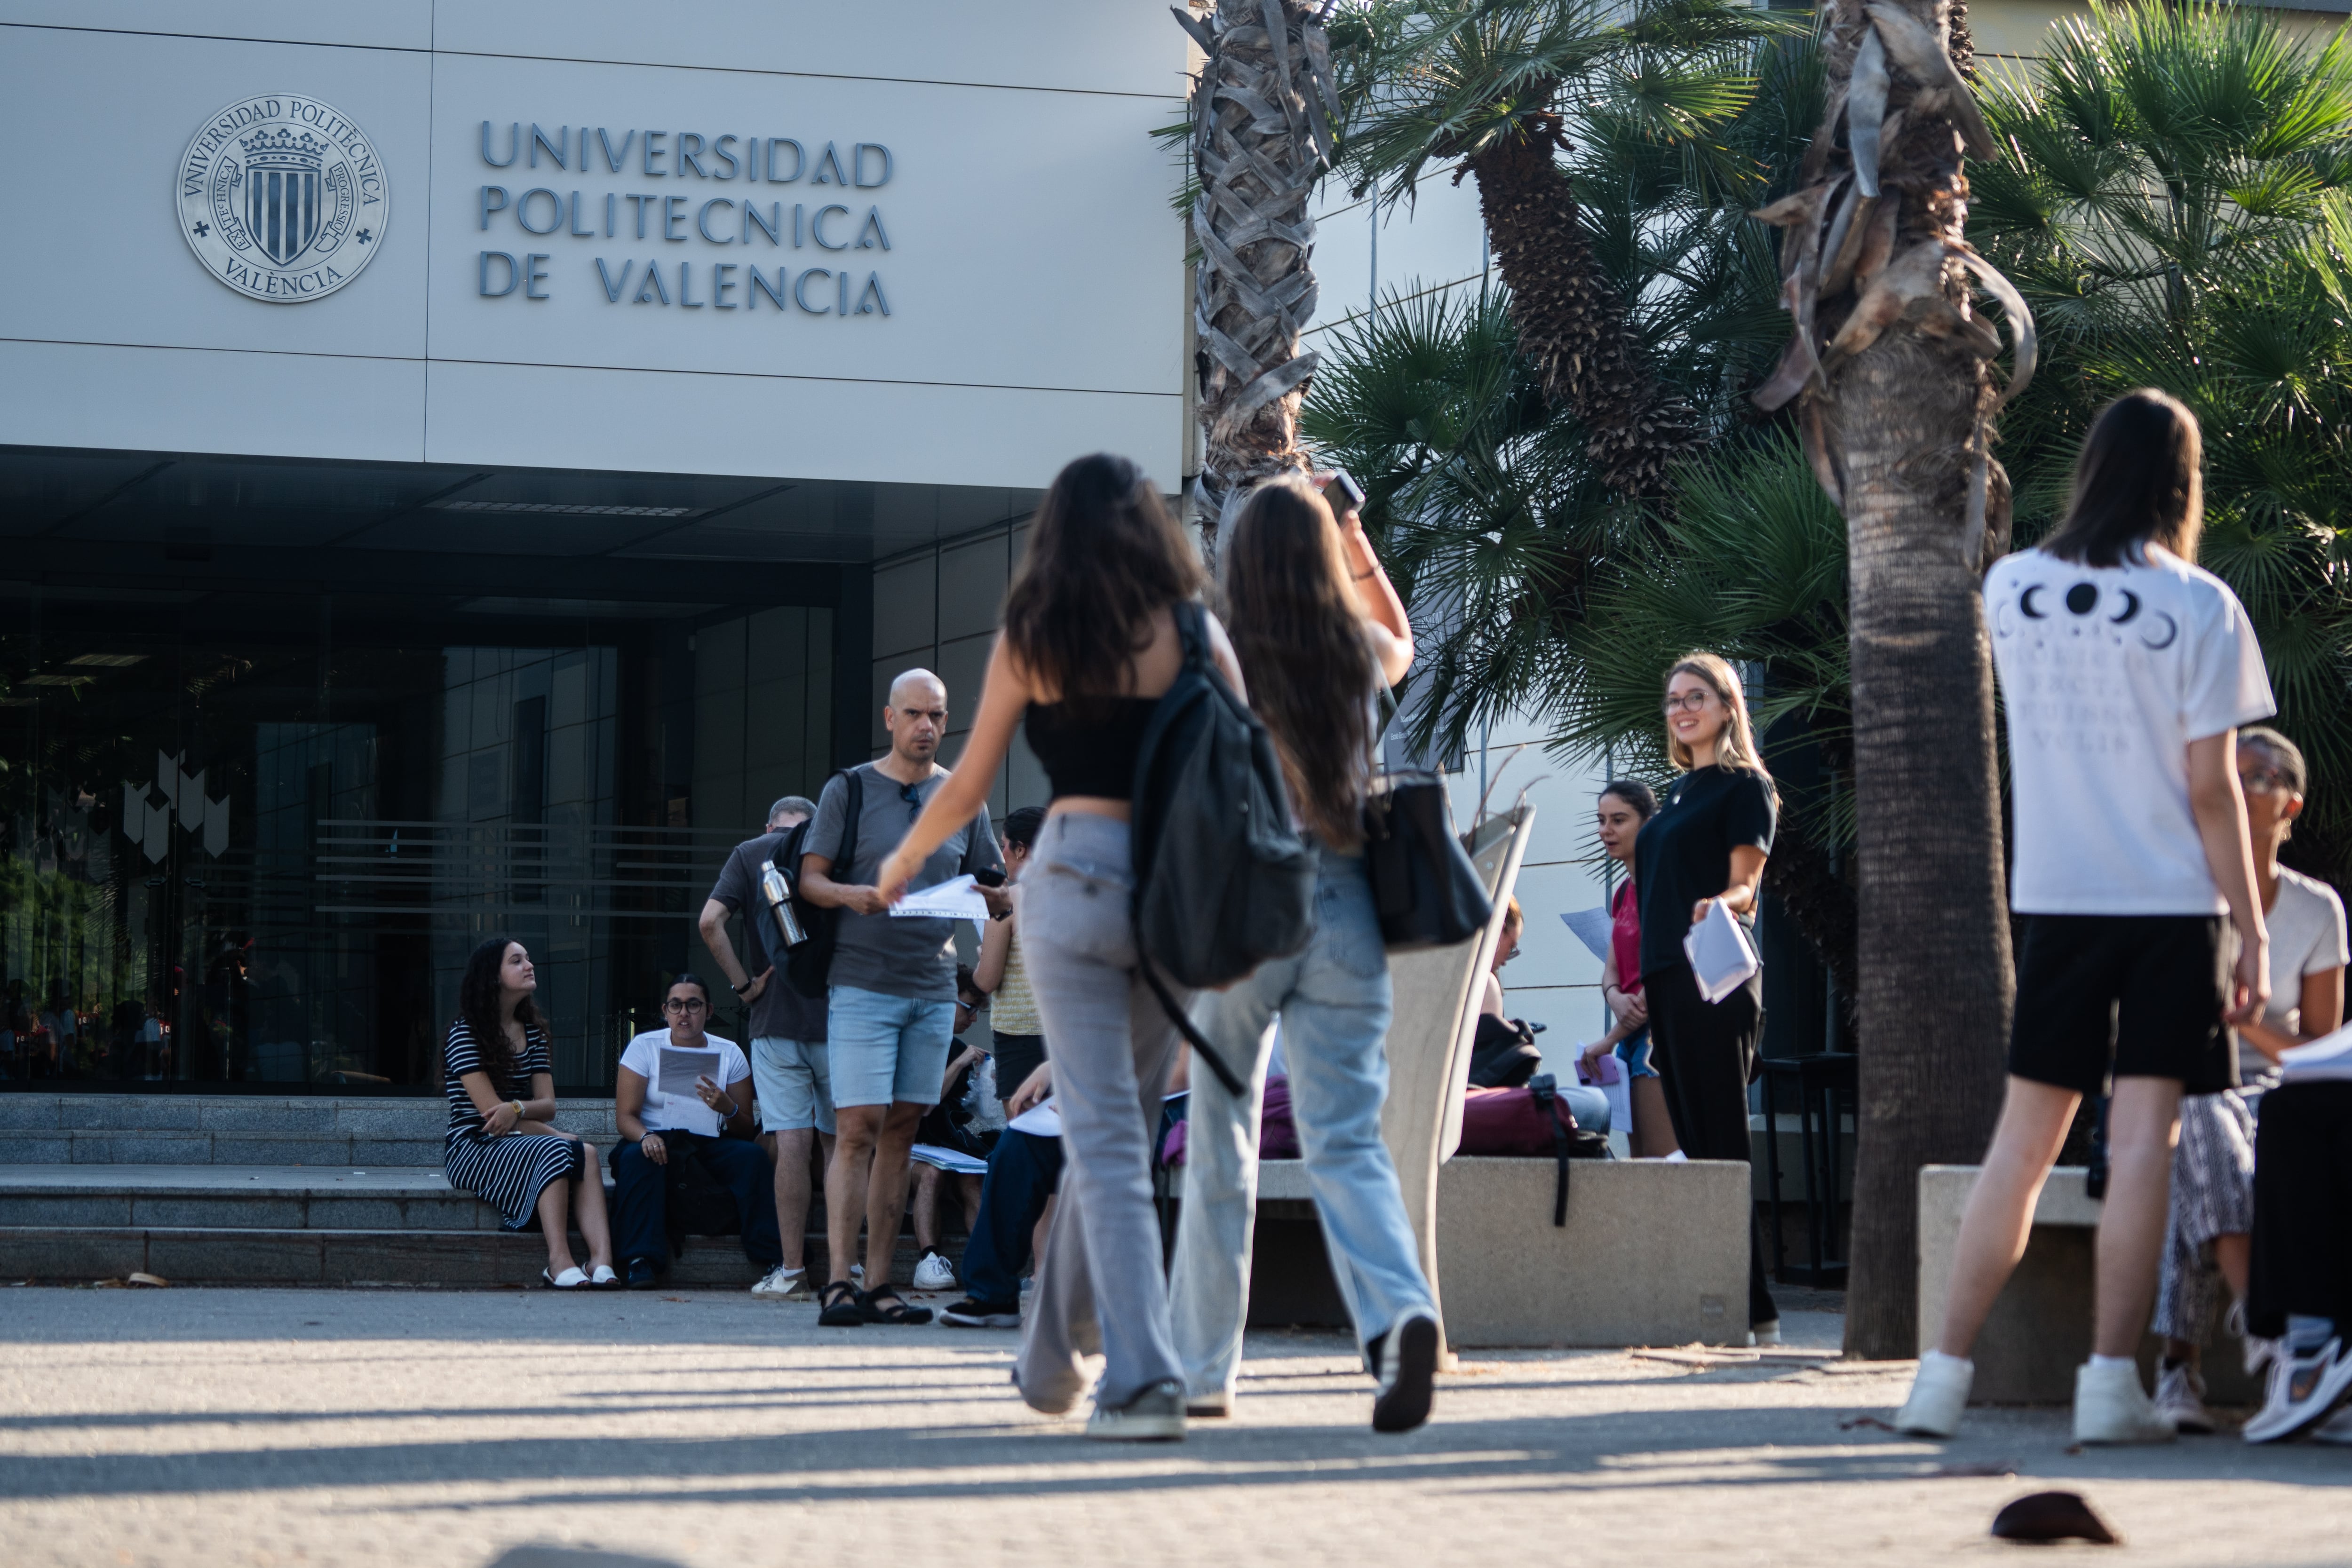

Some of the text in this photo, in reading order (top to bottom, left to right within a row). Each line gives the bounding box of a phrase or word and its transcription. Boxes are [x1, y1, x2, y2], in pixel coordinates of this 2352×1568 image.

[290, 101, 380, 206] POLITÈCNICA
[481, 120, 893, 187] UNIVERSIDAD
[334, 166, 350, 231] PROGRESSIO
[481, 185, 891, 250] POLITECNICA
[230, 233, 245, 247] EX
[225, 256, 343, 295] VALÈNCIA
[479, 251, 890, 316] DE VALENCIA
